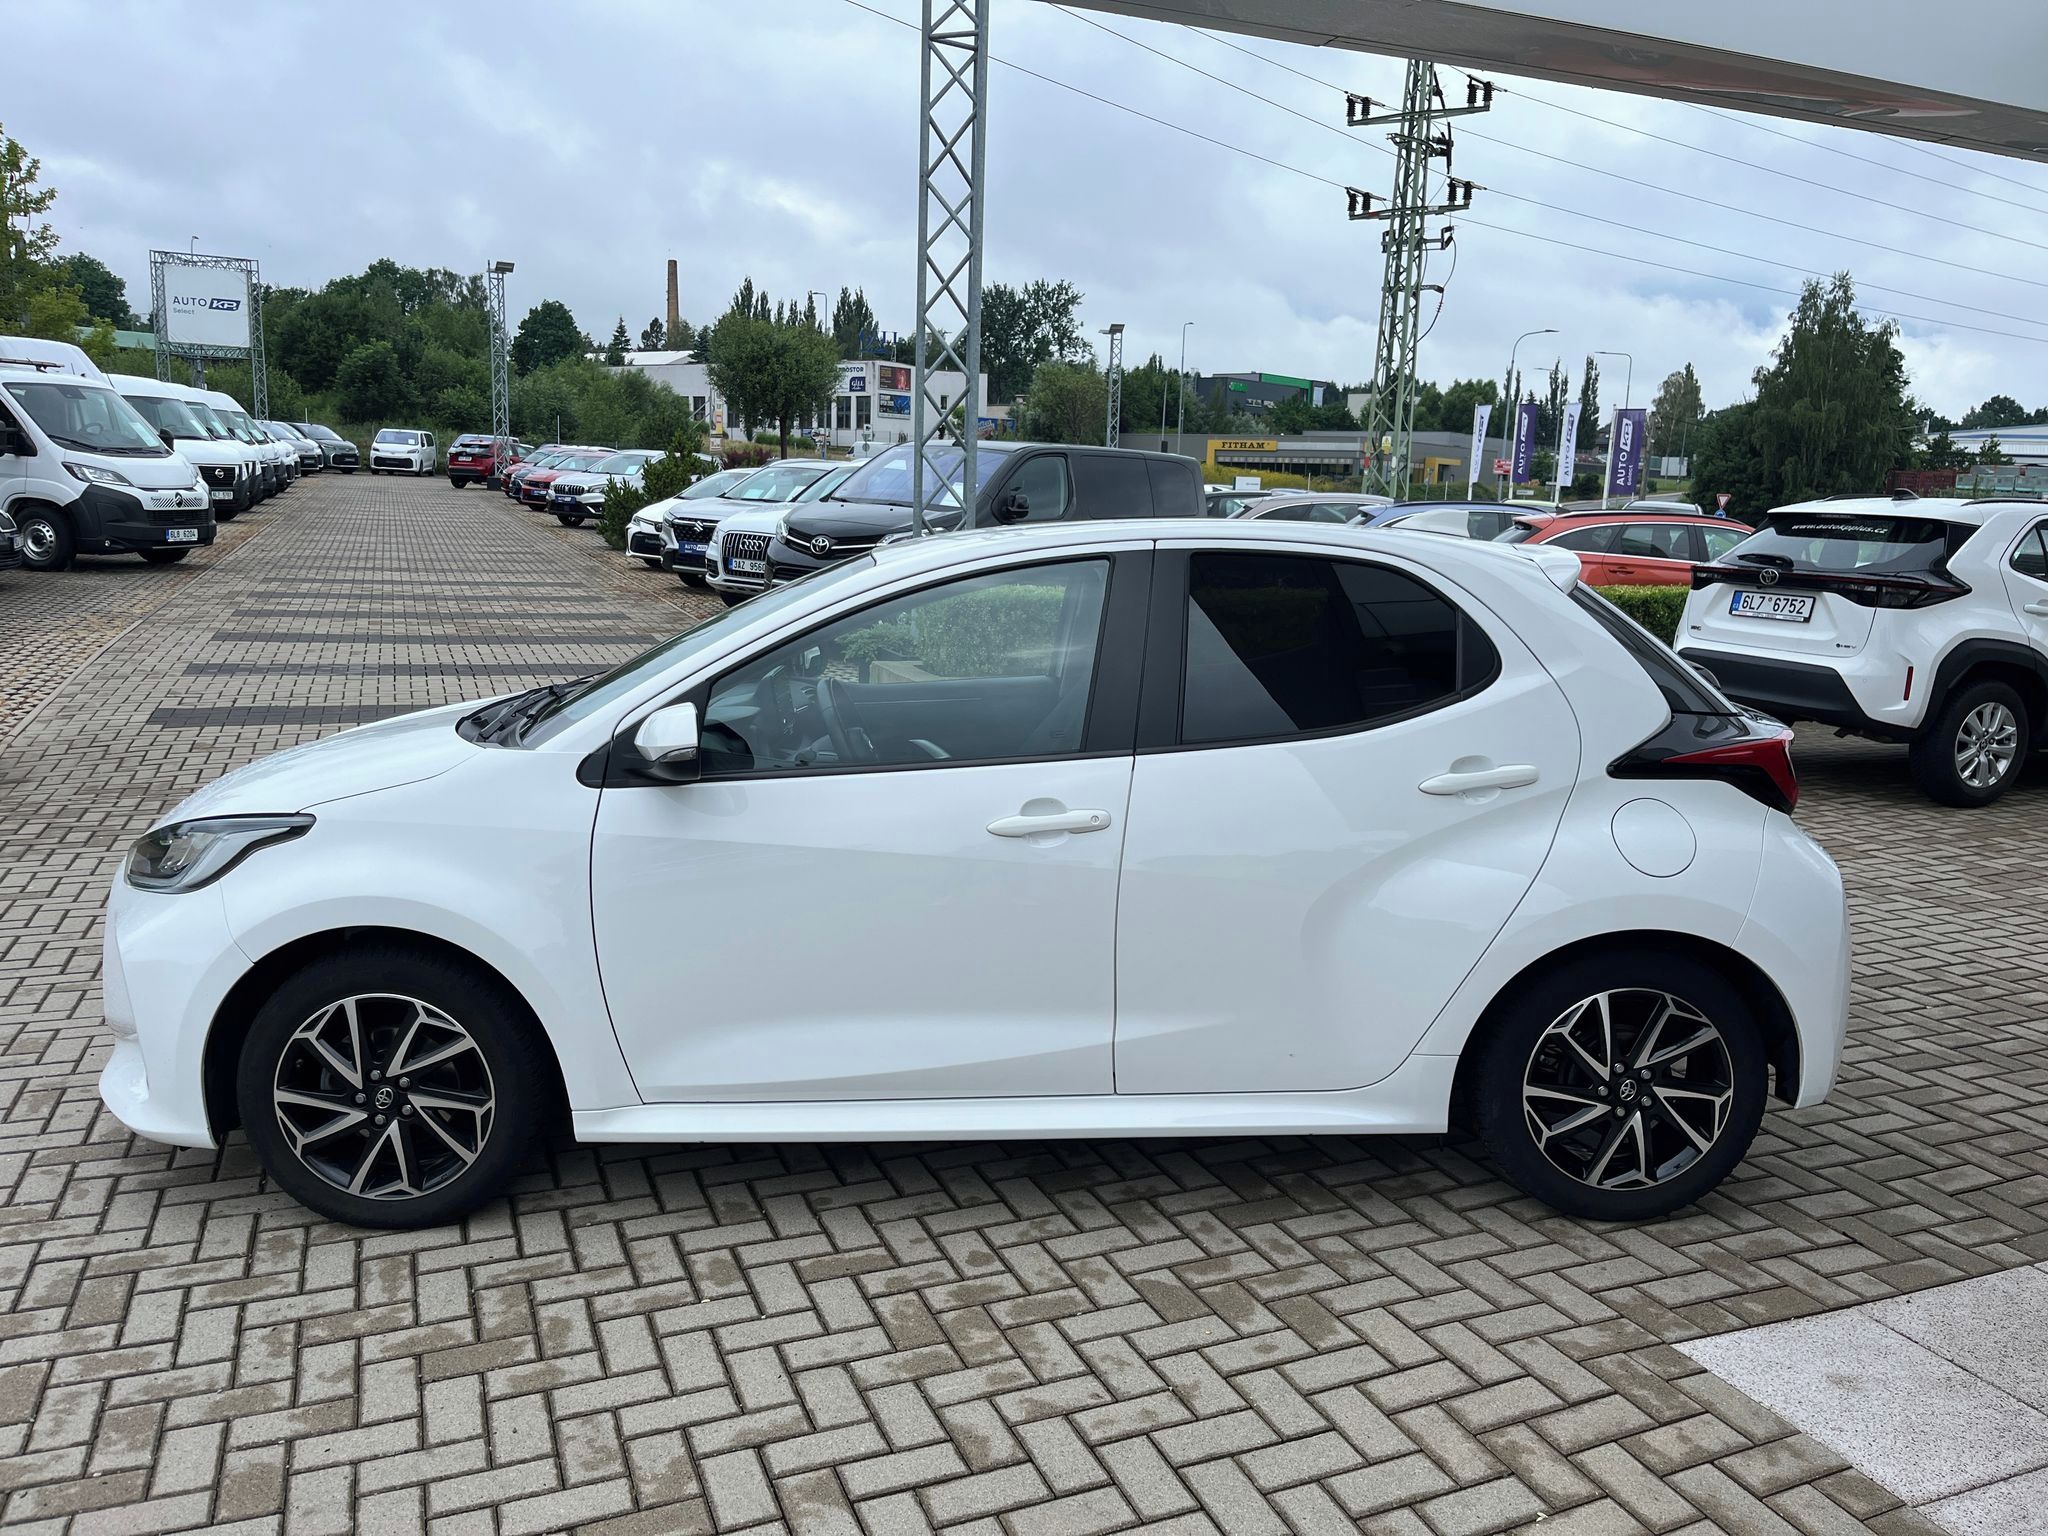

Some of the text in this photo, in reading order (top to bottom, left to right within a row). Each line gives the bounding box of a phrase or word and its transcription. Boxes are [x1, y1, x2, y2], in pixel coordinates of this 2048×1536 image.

[173, 296, 207, 307] AUTO
[173, 307, 195, 315] Select
[1221, 441, 1265, 449] FITHAM
[1517, 442, 1526, 475] AUTO
[1564, 443, 1572, 477] AUTO
[1616, 451, 1628, 486] AUTO
[733, 560, 745, 569] 3AZ
[1742, 594, 1766, 611] 6L7
[1773, 597, 1806, 615] 6752
